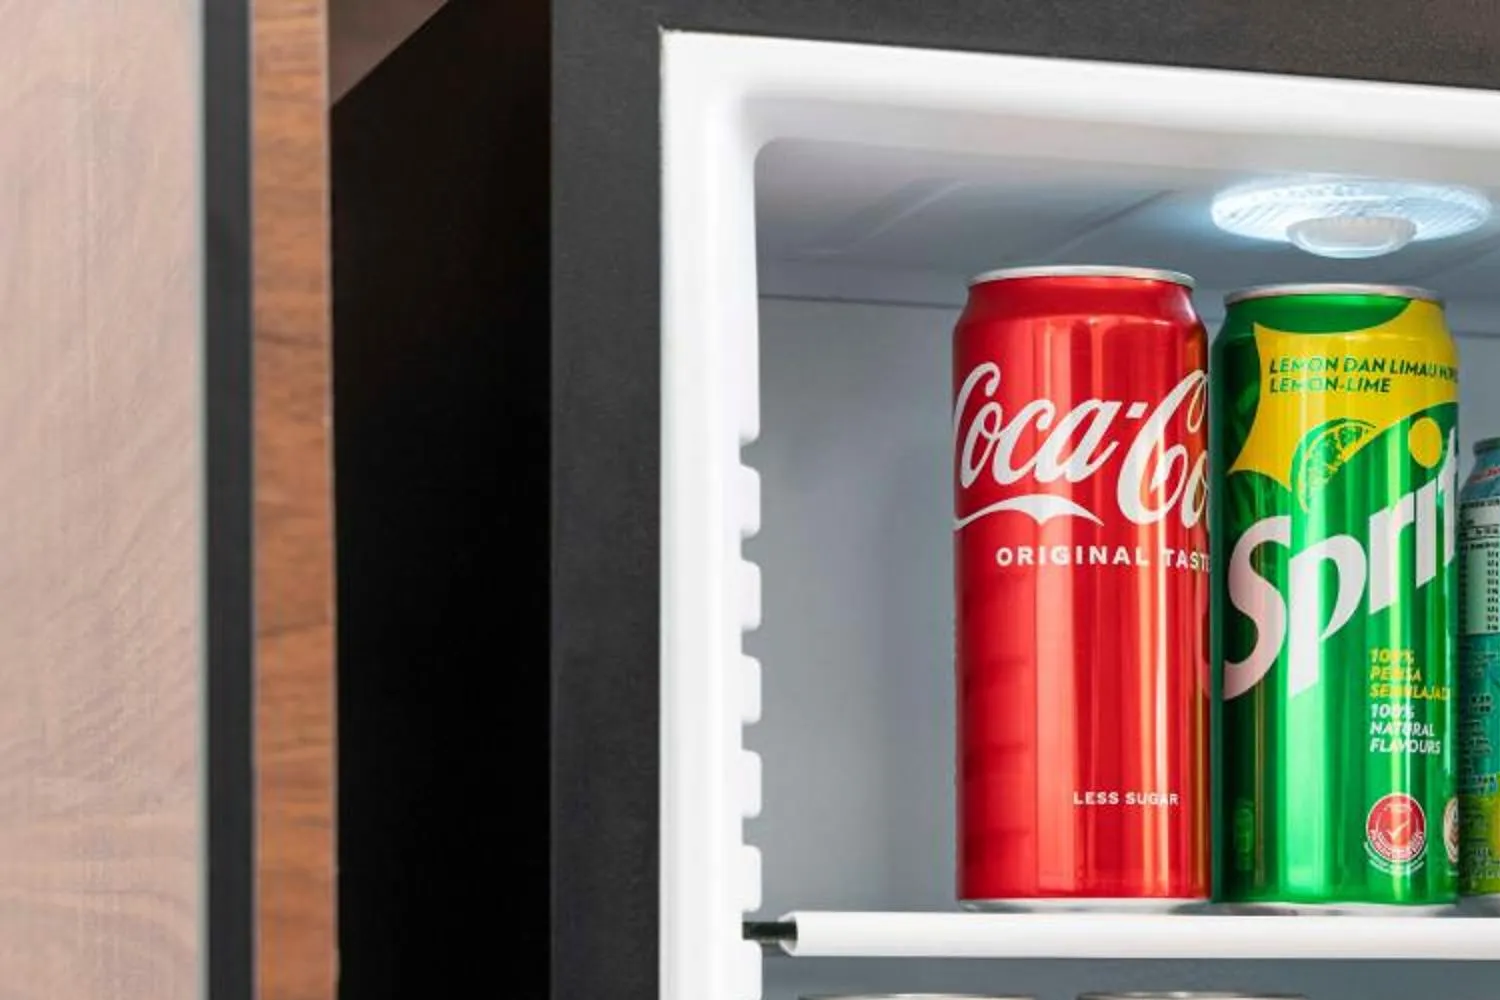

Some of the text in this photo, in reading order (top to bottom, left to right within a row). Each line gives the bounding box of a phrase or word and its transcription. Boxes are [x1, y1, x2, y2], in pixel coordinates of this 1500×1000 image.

[1270, 358, 1339, 374] LEMON
[1344, 358, 1385, 373] DAN
[1270, 377, 1391, 393] LEMON-LIME
[953, 362, 1210, 528] Coca-Co
[996, 546, 1149, 566] ORIGINAL
[1370, 648, 1415, 663] 100%
[1370, 703, 1415, 719] 100%
[1370, 721, 1435, 737] NATURAL
[1370, 738, 1441, 754] FLAVOURS
[1073, 791, 1179, 805] LESS SUGAR
